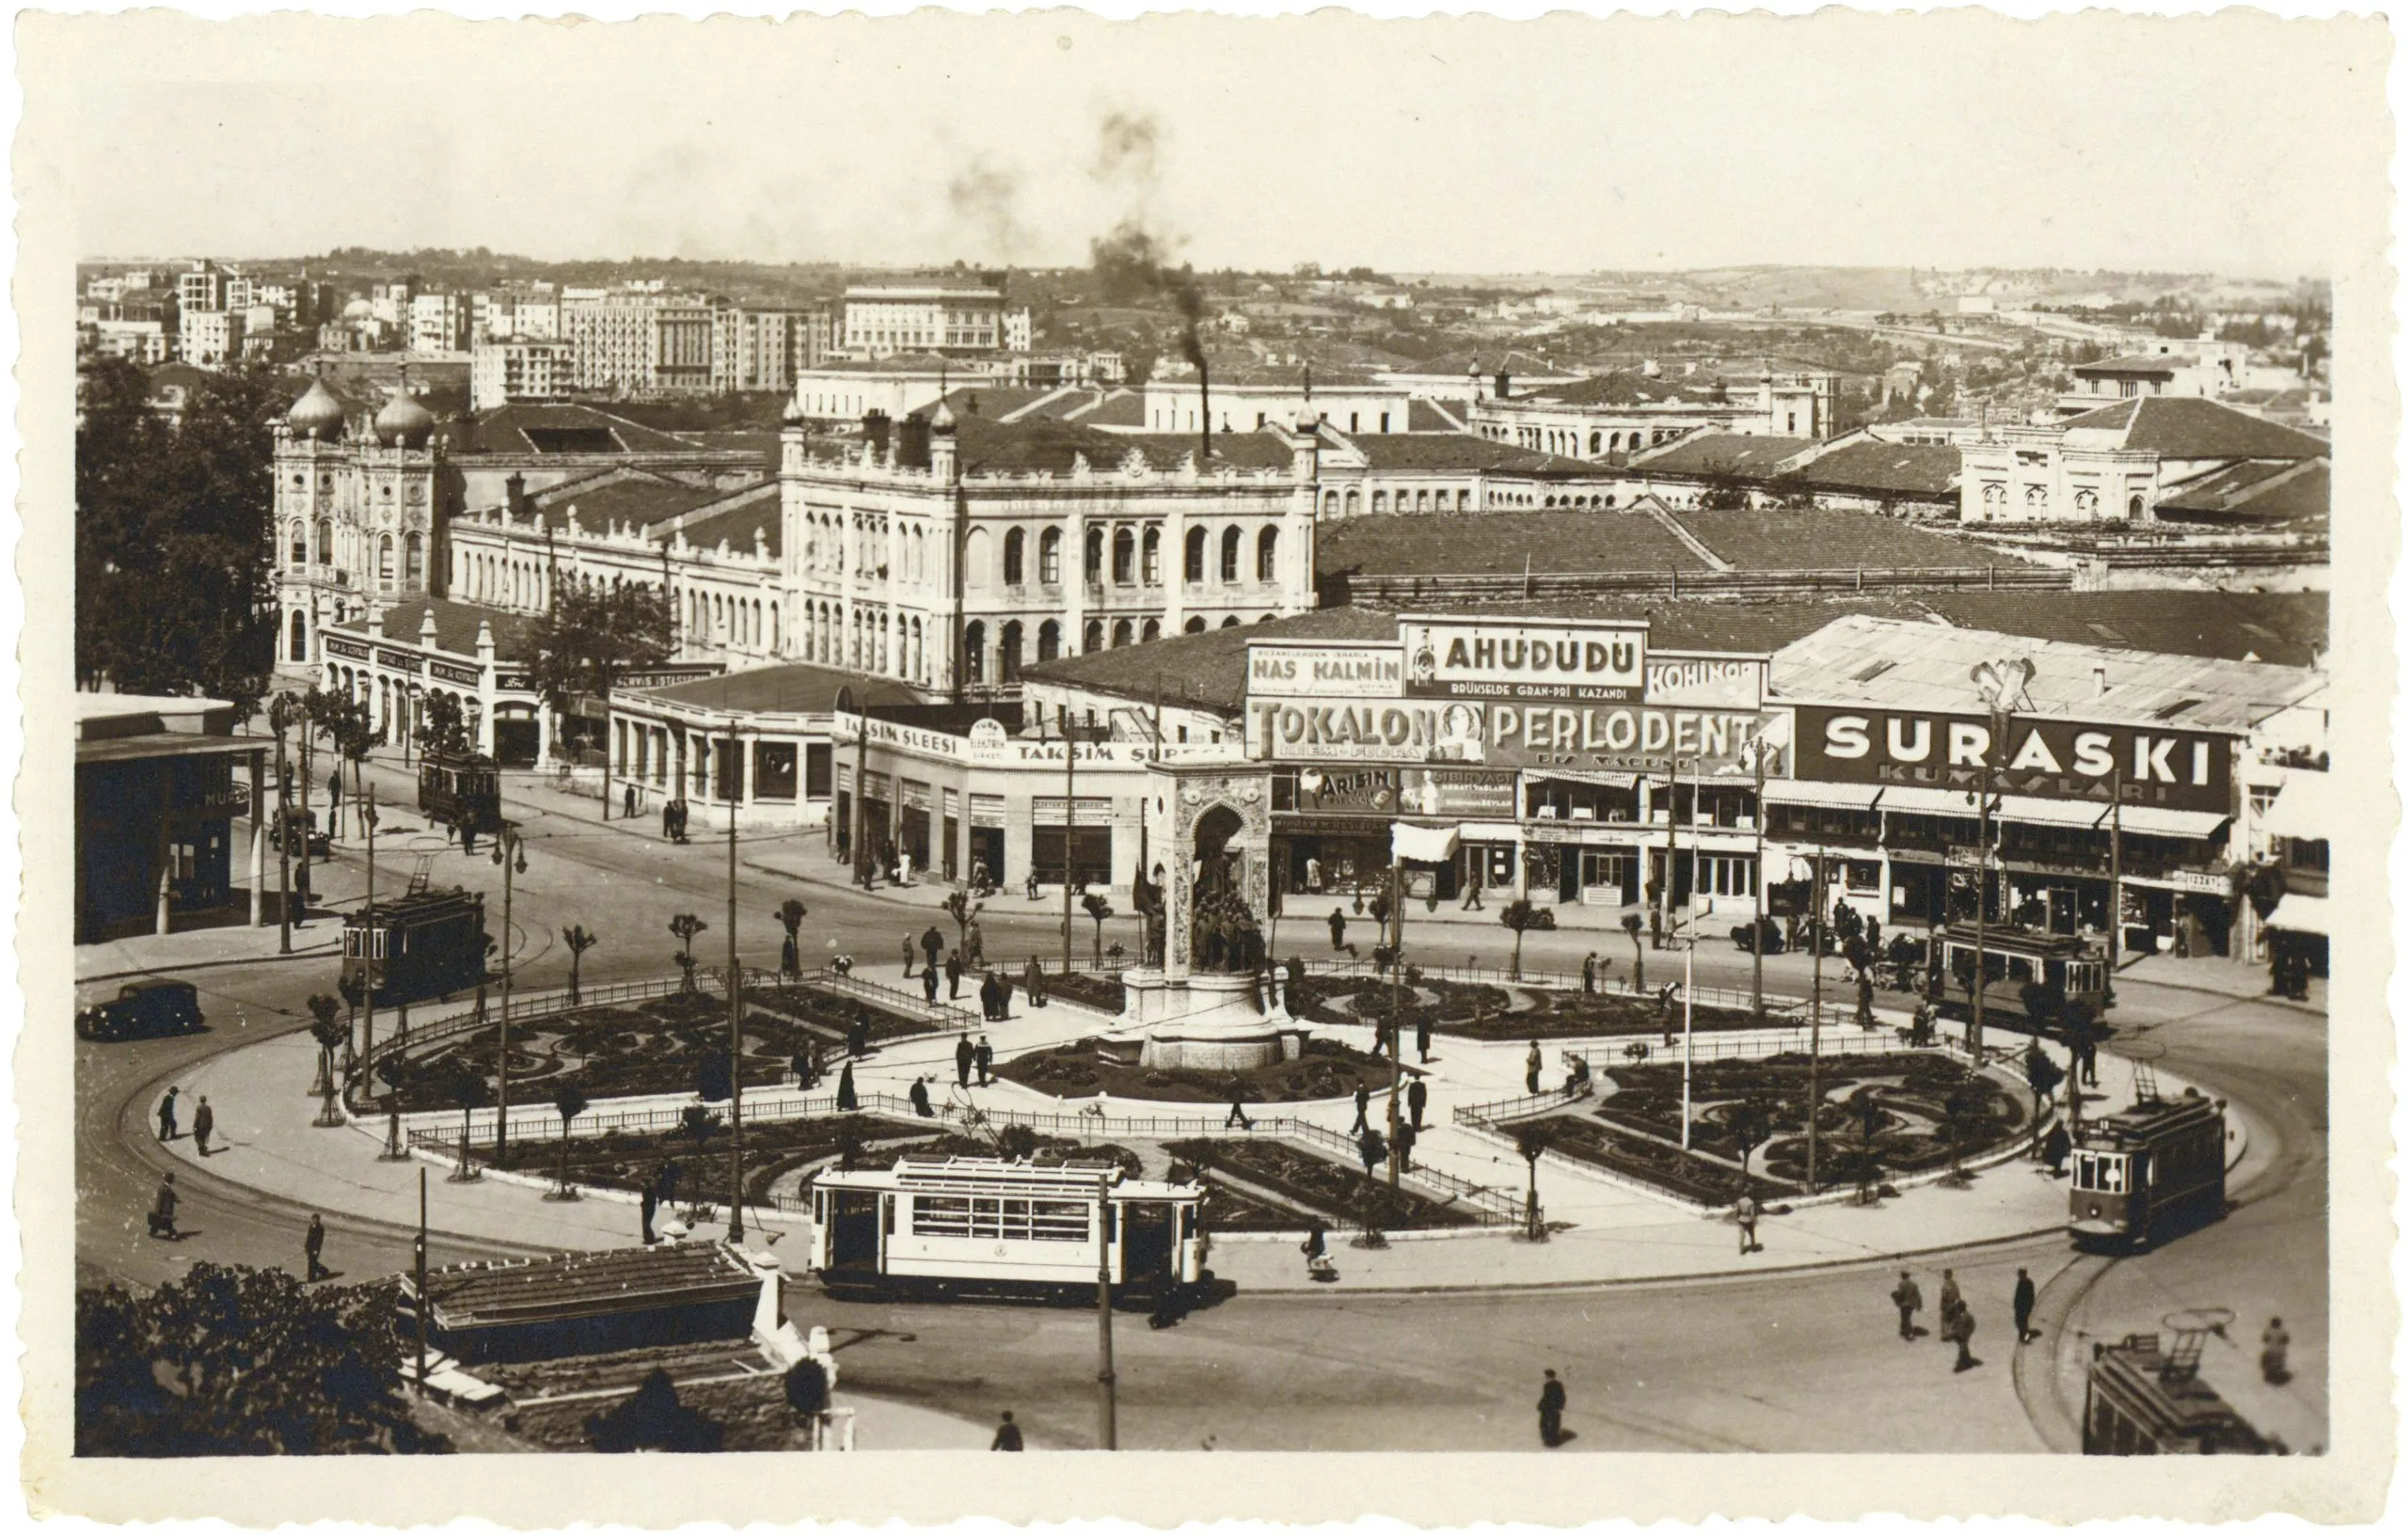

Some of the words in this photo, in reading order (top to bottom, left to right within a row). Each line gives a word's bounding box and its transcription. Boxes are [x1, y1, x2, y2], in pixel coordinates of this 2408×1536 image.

[1254, 659, 1296, 680] HAS
[1313, 657, 1400, 681] KALMİN
[1445, 638, 1634, 673] AHUDUDU
[1451, 681, 1510, 696] BRÜKSELDE
[1517, 685, 1570, 698] GRAN-PRİ
[1578, 688, 1626, 700] KAZANDI
[1251, 703, 1435, 760] TOKALON
[1493, 705, 1756, 756] PERLODENT
[1824, 716, 2209, 785] SURASKI
